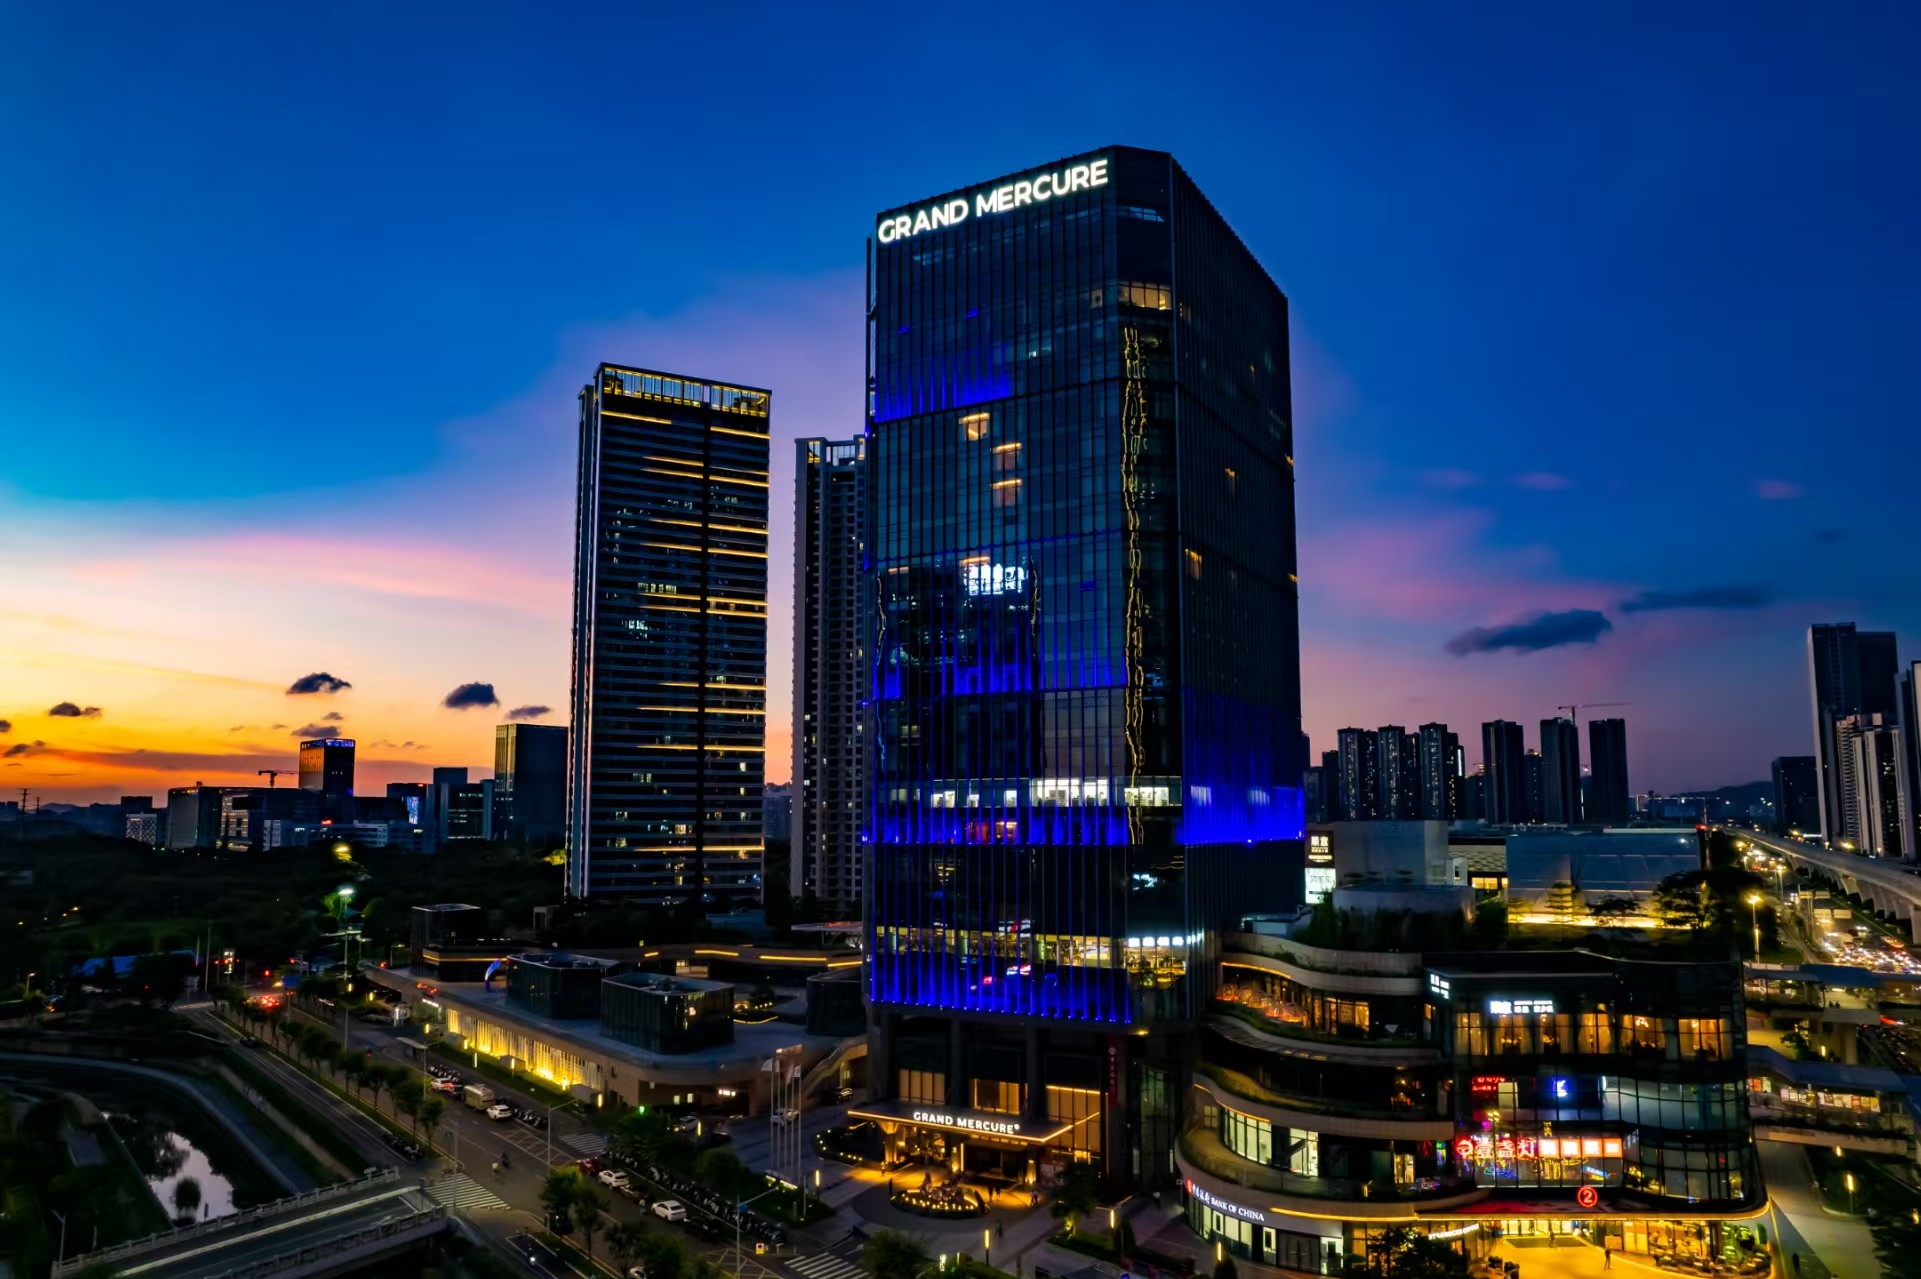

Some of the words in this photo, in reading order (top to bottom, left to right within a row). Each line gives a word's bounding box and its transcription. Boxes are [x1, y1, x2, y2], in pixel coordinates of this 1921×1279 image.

[878, 199, 969, 243] GRAND
[976, 159, 1108, 217] MERCURE
[913, 1111, 953, 1125] GRAND
[957, 1117, 1014, 1134] MERCURE
[1211, 1197, 1228, 1210] BANK
[1228, 1204, 1237, 1213] OF
[1238, 1207, 1264, 1221] CHINA
